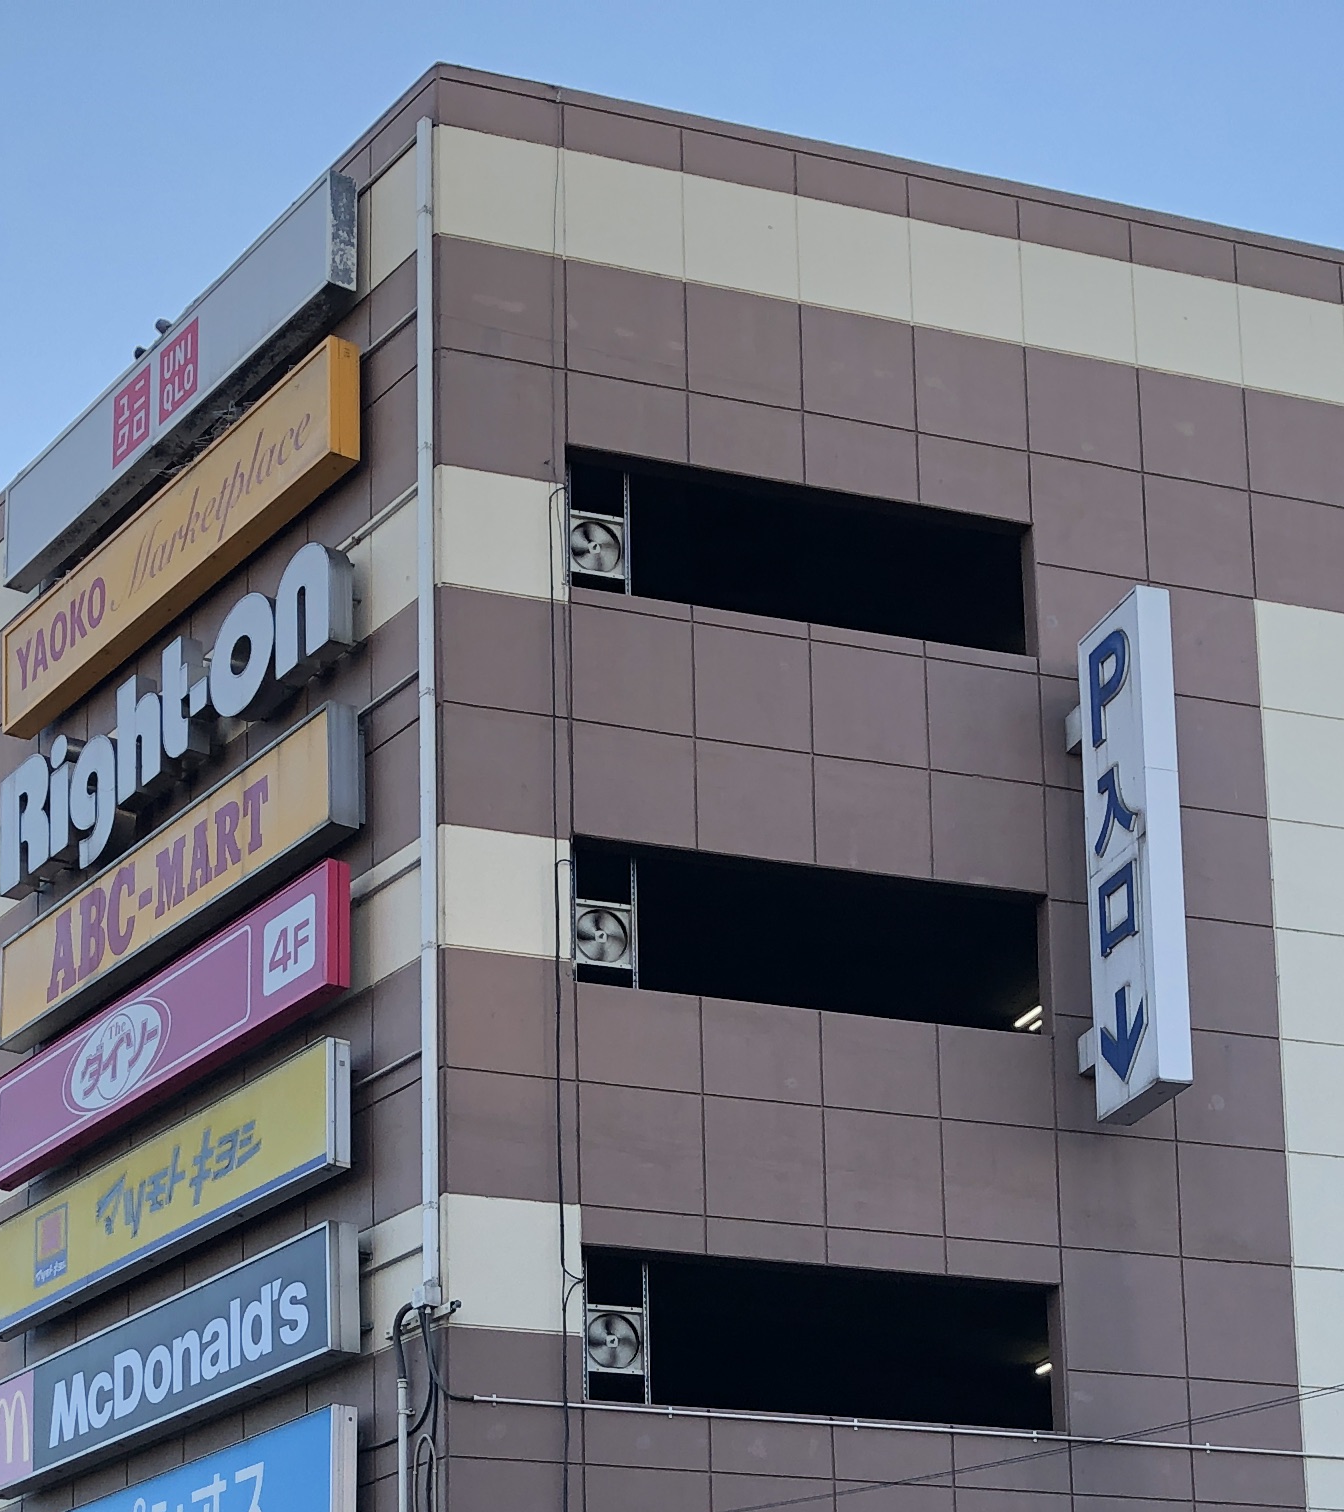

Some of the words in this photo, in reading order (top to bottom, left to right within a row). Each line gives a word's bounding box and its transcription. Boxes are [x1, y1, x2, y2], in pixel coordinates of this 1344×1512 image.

[163, 332, 192, 380] UNI
[163, 363, 194, 412] QLO
[15, 576, 106, 691] YAOKO
[110, 411, 312, 613] Marketplace
[46, 774, 270, 1004] ABC-MART
[268, 917, 312, 975] 4F
[79, 1017, 159, 1100] ダイソー
[108, 1021, 126, 1039] The
[96, 1120, 262, 1239] マツモトキヨシ
[48, 1277, 310, 1450] McDonald's
